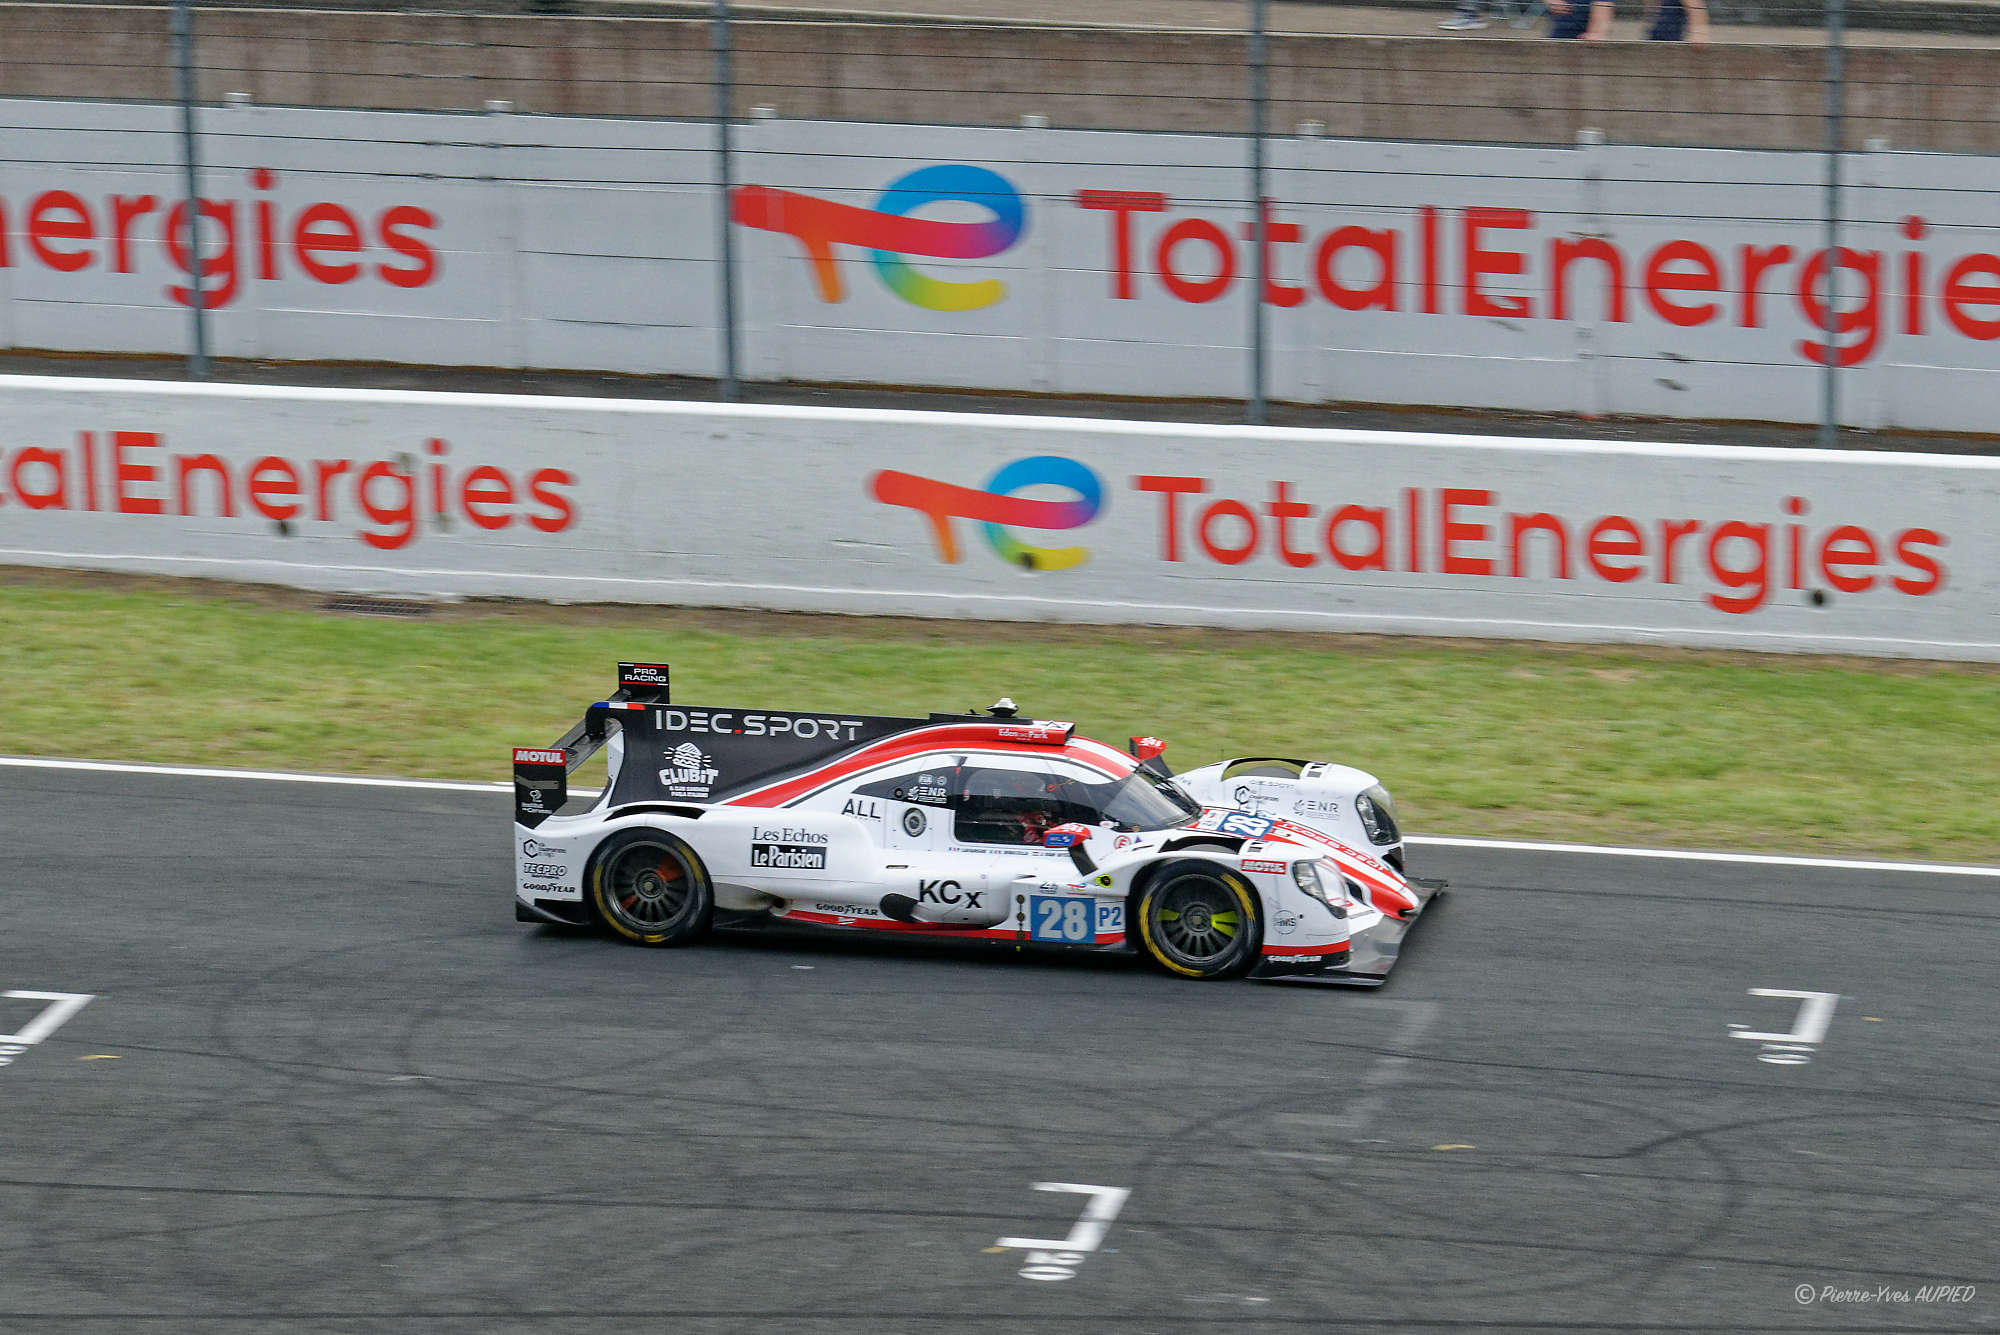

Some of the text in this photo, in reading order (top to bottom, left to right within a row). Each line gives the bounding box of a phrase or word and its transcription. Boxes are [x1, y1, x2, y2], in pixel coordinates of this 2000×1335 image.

[0, 168, 440, 309] ergies
[0, 431, 577, 550] alEnergies
[1131, 474, 1948, 614] TotalEnergies
[624, 674, 667, 682] RACING
[514, 750, 564, 763] MOTUL
[841, 798, 881, 820] ALL
[752, 826, 829, 844] Les Echos
[523, 862, 568, 876] TECPRO
[1038, 899, 1122, 941] 28 P2
